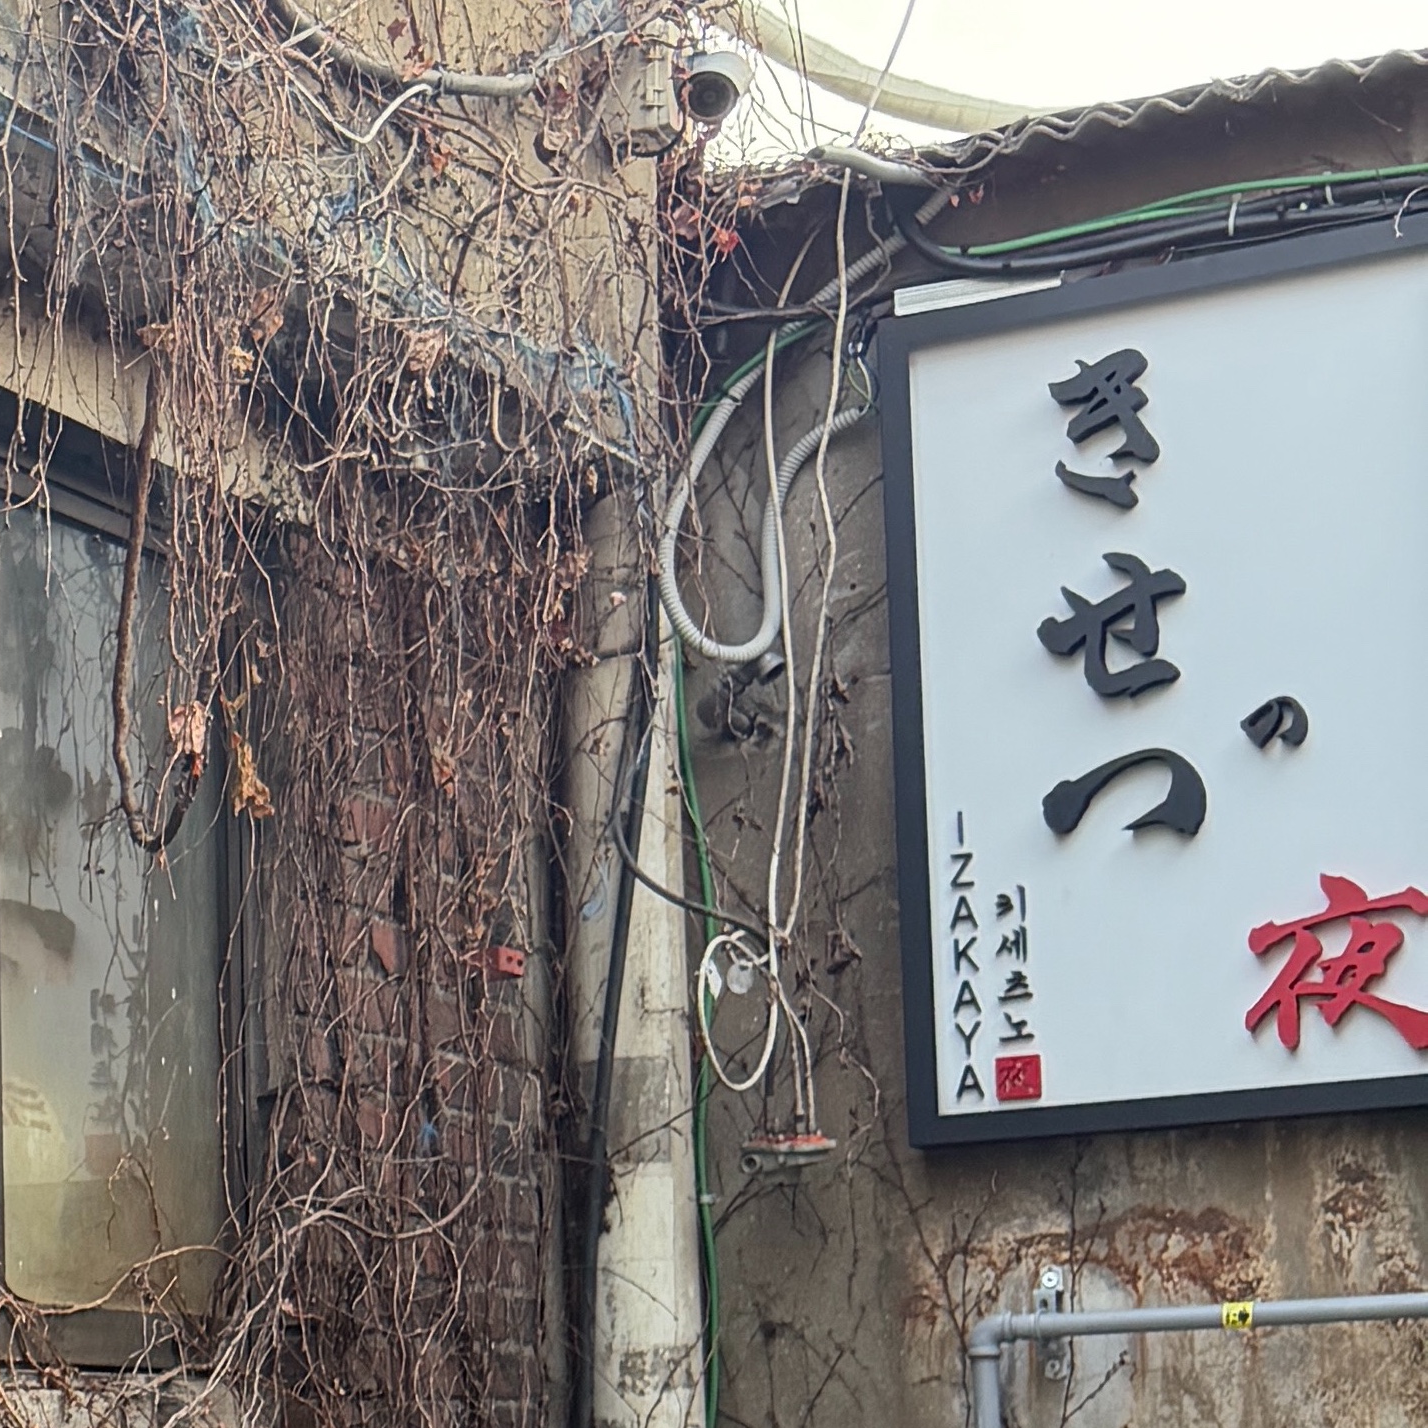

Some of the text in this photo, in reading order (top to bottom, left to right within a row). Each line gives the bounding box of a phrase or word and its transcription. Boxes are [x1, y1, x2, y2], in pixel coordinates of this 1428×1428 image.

[1036, 348, 1207, 839] きせつ
[950, 811, 985, 1100] IZAKAYA
[995, 884, 1035, 1043] 키세츠노
